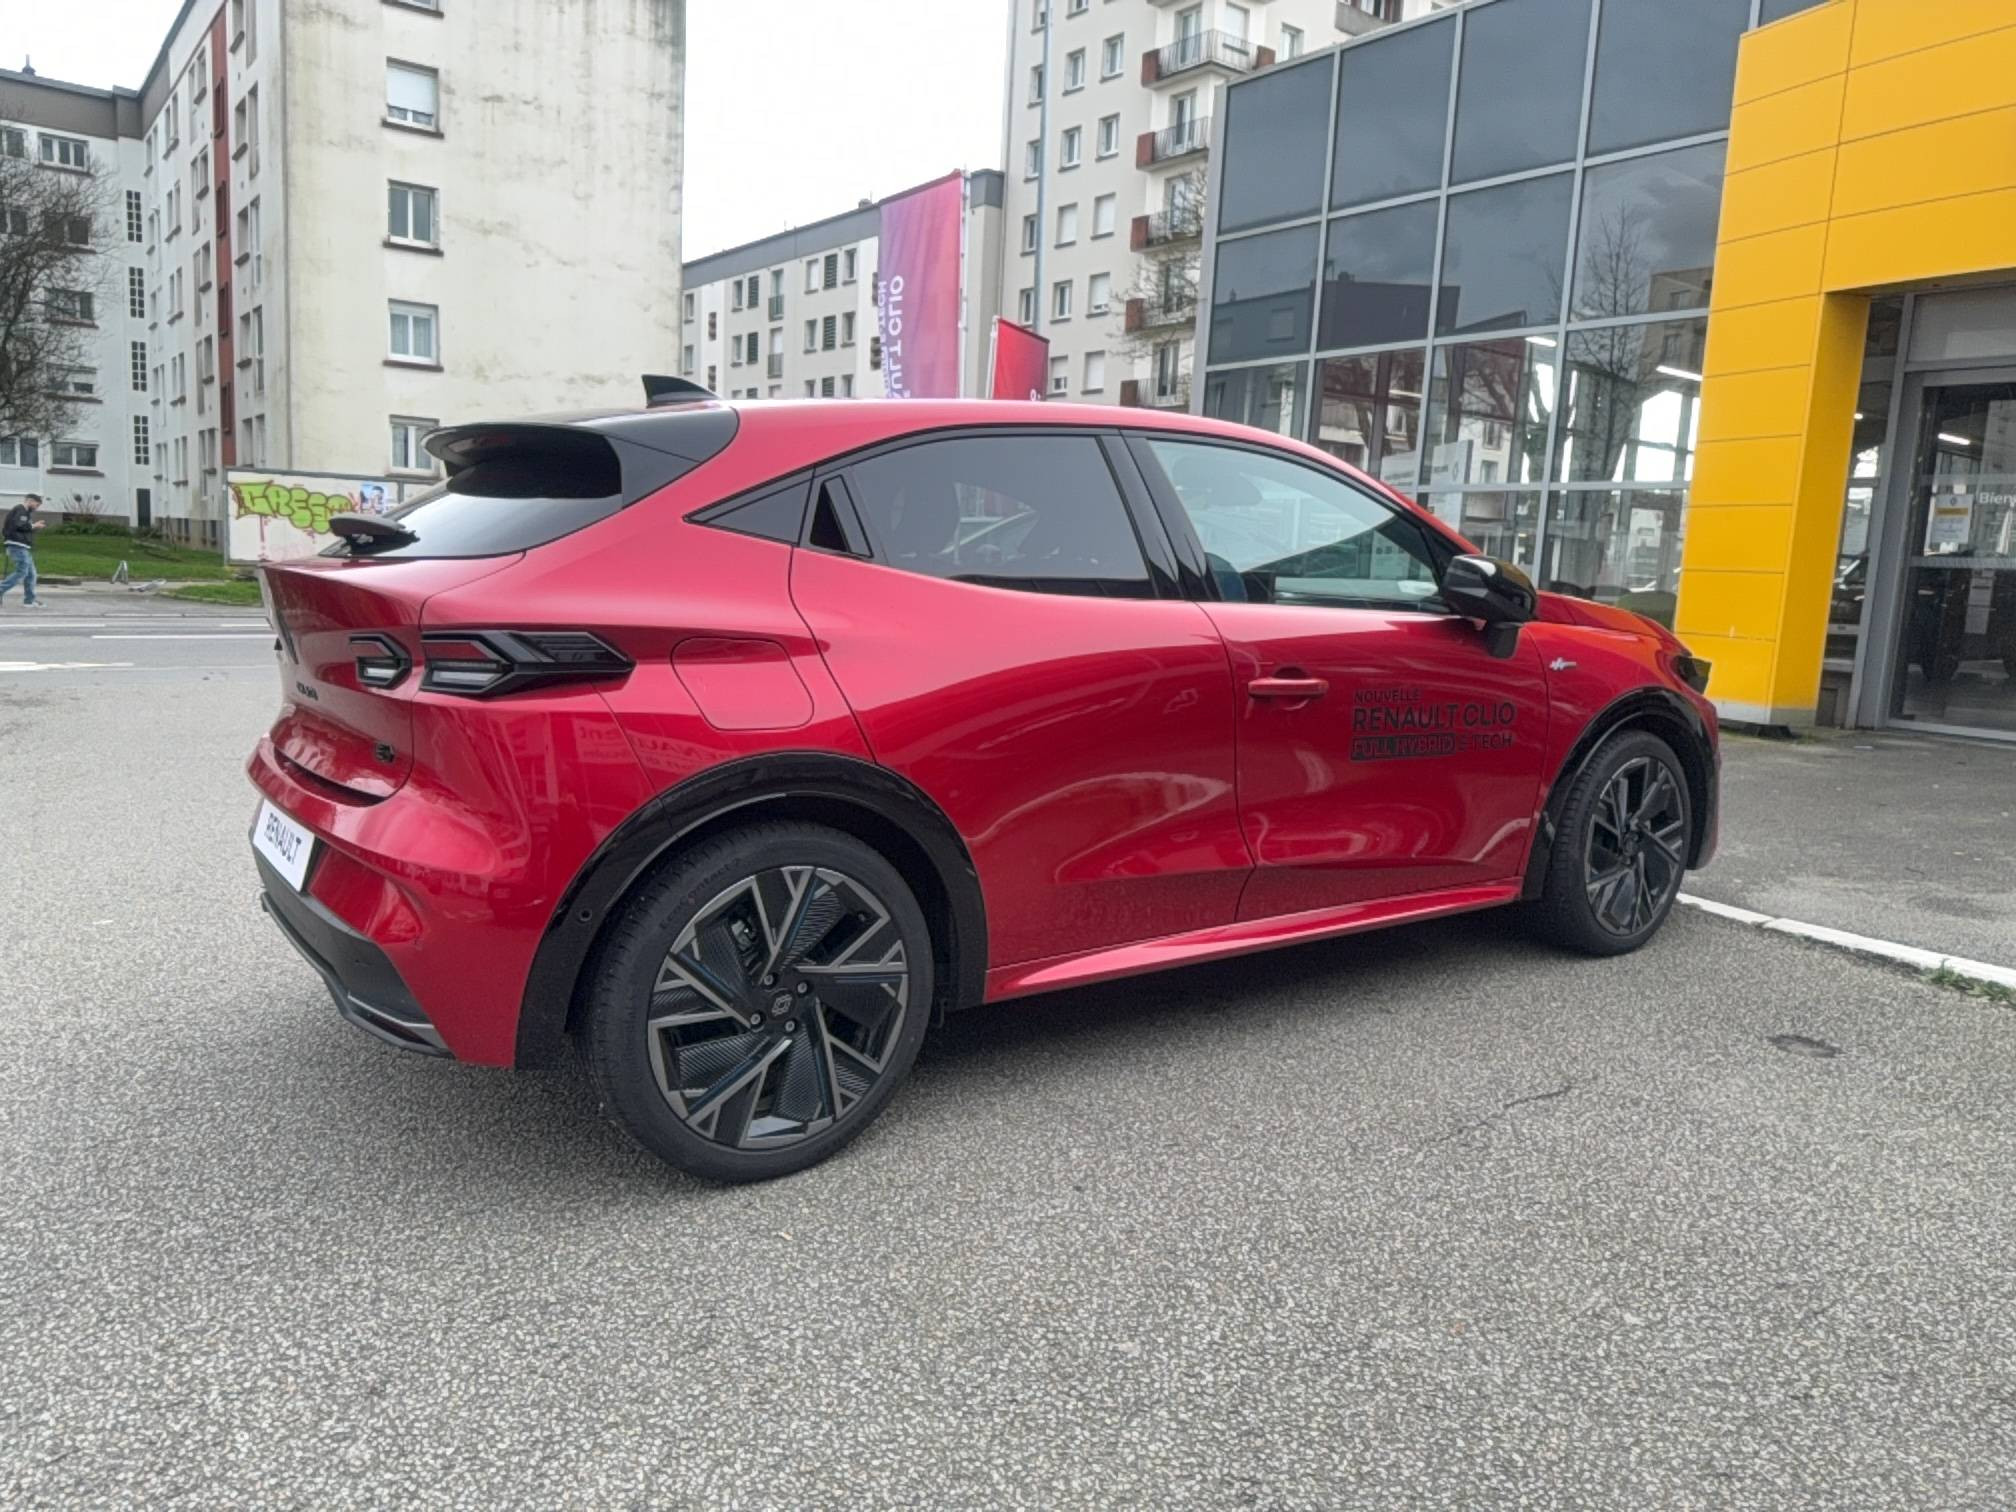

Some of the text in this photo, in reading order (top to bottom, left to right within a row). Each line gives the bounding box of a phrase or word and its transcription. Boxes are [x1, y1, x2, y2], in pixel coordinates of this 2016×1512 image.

[1354, 688, 1420, 703] NOUVELLE
[1353, 701, 1516, 731] RENAULT CLIO
[264, 812, 302, 865] RENAULT
